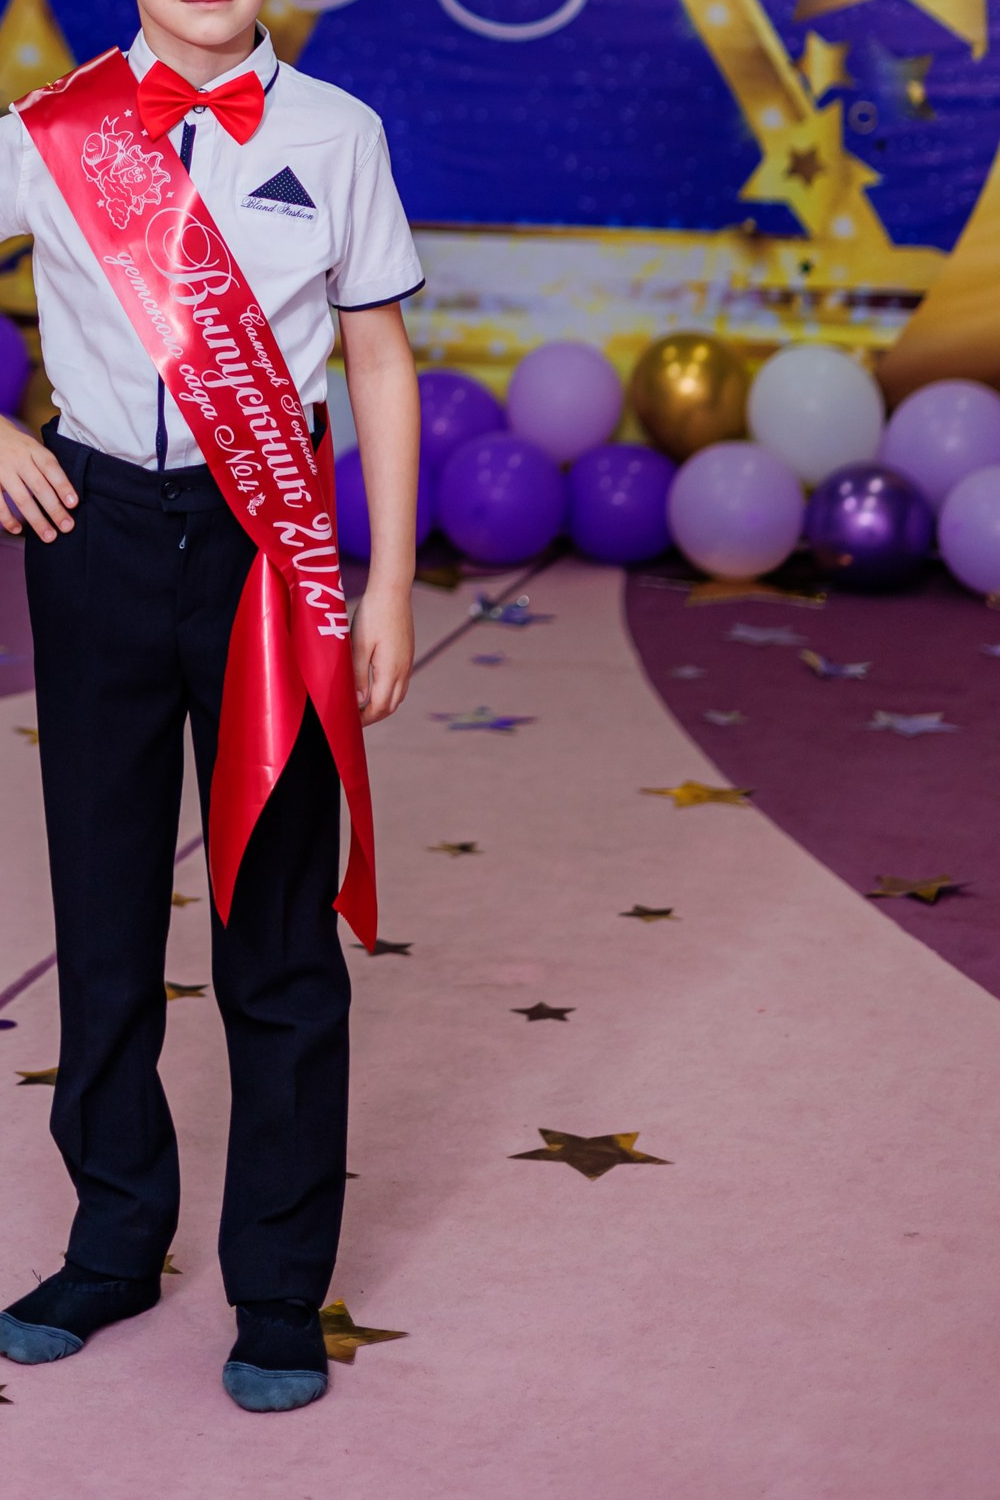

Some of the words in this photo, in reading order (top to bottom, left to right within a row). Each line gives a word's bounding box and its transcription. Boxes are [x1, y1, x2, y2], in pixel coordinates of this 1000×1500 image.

[276, 202, 315, 221] Fashion
[103, 251, 184, 360] детского
[178, 363, 218, 421] сада
[145, 207, 312, 509] Выпускник
[239, 303, 290, 388] Самедов
